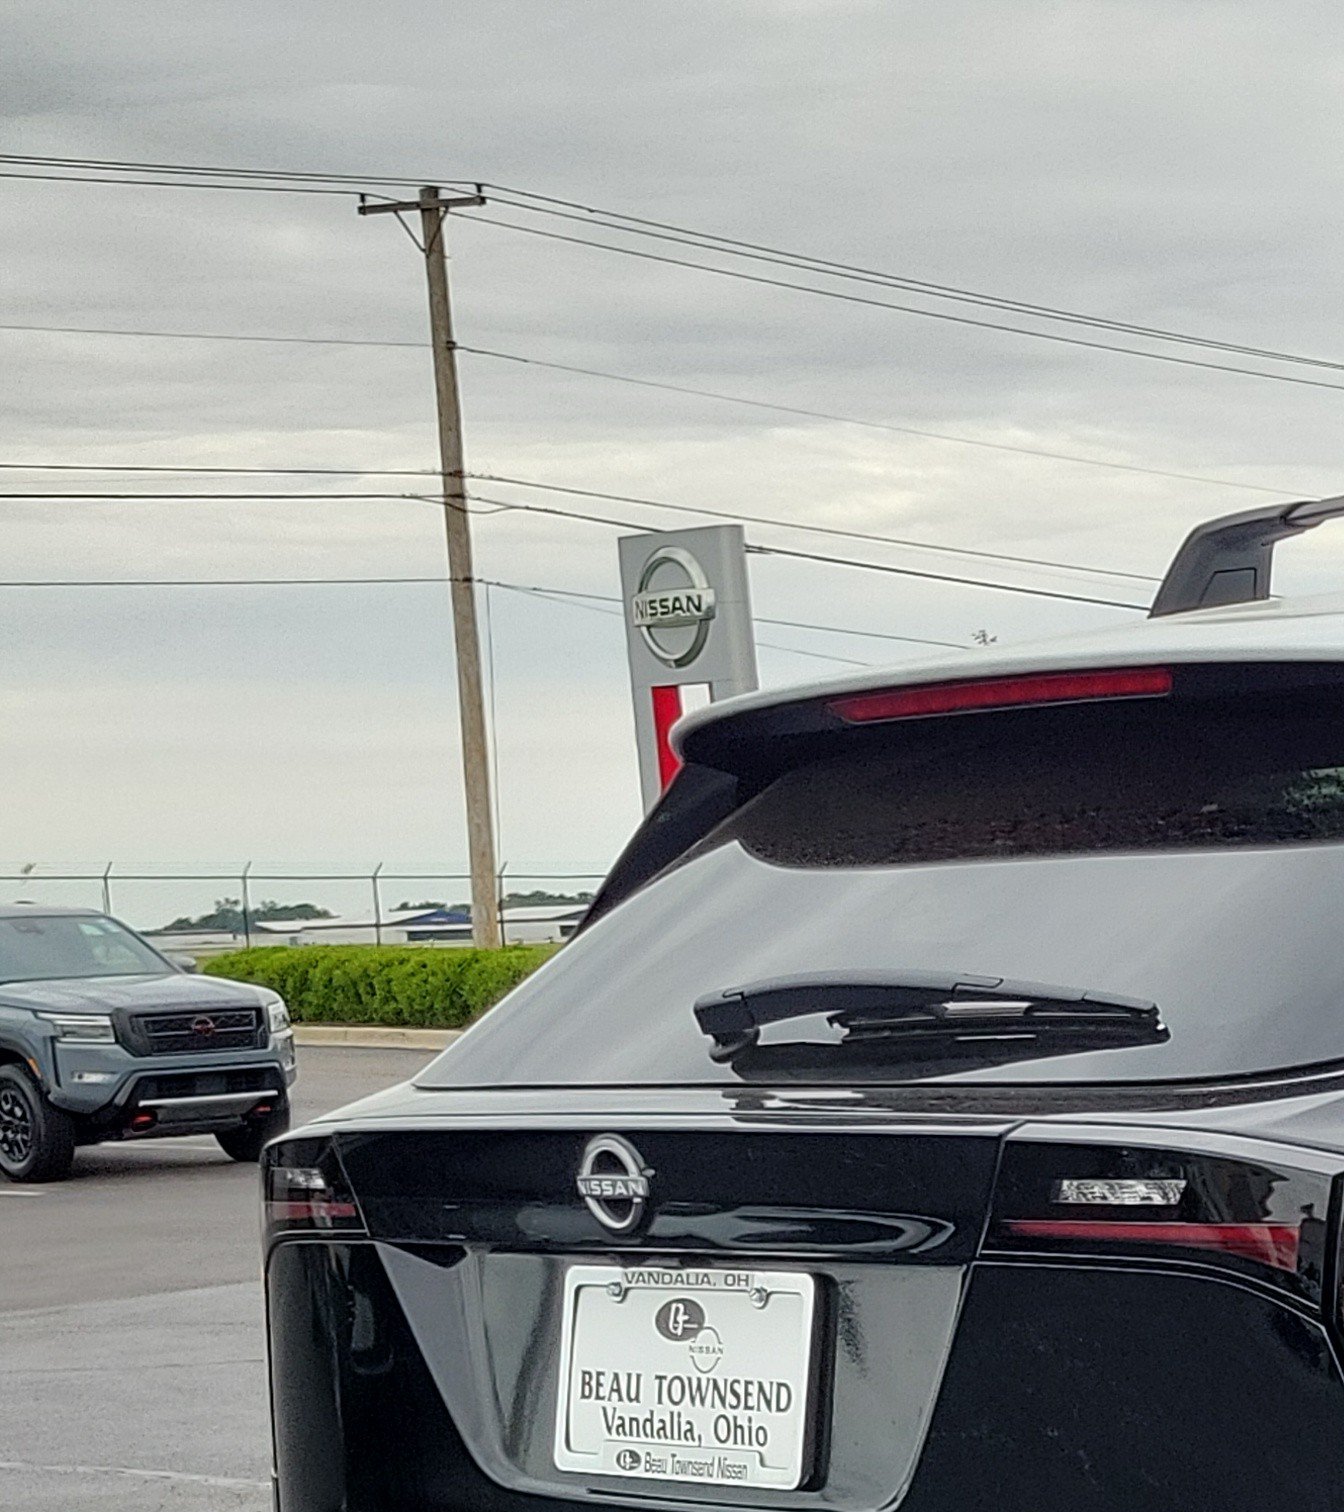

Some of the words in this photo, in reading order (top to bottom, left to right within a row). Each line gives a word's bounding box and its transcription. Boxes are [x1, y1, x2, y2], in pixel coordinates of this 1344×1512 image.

[635, 594, 703, 620] NISSAN
[577, 1180, 645, 1196] NISSAN
[723, 1273, 750, 1287] OH
[688, 1345, 724, 1355] NISSAN
[580, 1370, 643, 1404] BEAU
[654, 1374, 793, 1413] TOWNSEND
[601, 1406, 703, 1447] Vandalia,
[713, 1414, 769, 1447] Ohio
[644, 1452, 667, 1474] Beau
[670, 1454, 714, 1478] Townsend
[716, 1457, 748, 1480] Nissan
